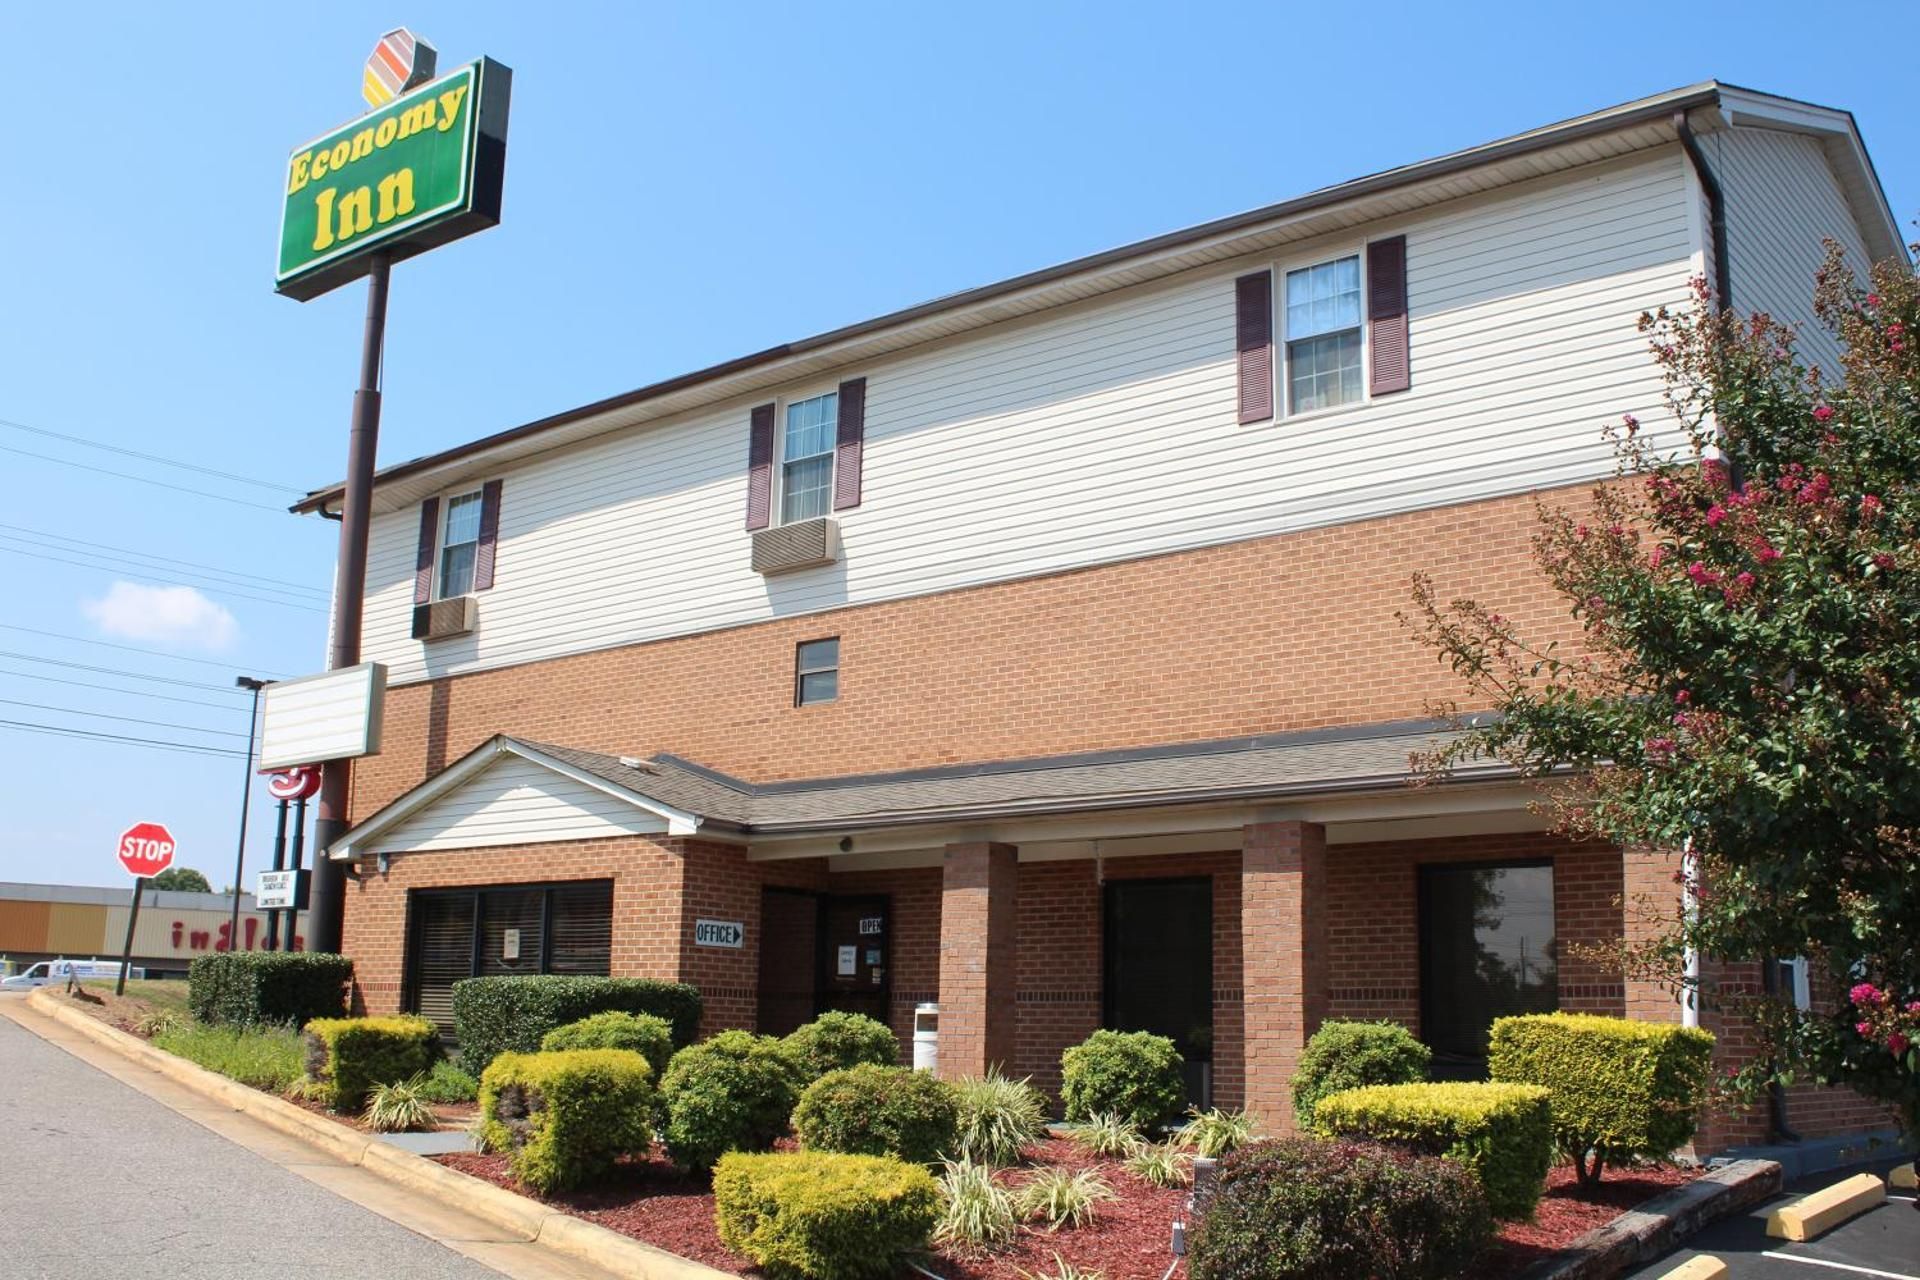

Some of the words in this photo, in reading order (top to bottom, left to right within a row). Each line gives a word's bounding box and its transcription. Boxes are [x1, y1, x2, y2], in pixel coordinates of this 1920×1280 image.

[288, 85, 467, 195] Economy
[313, 168, 416, 252] Inn
[122, 837, 172, 862] STOP
[697, 923, 732, 944] OFFICE
[862, 919, 882, 933] OPEN
